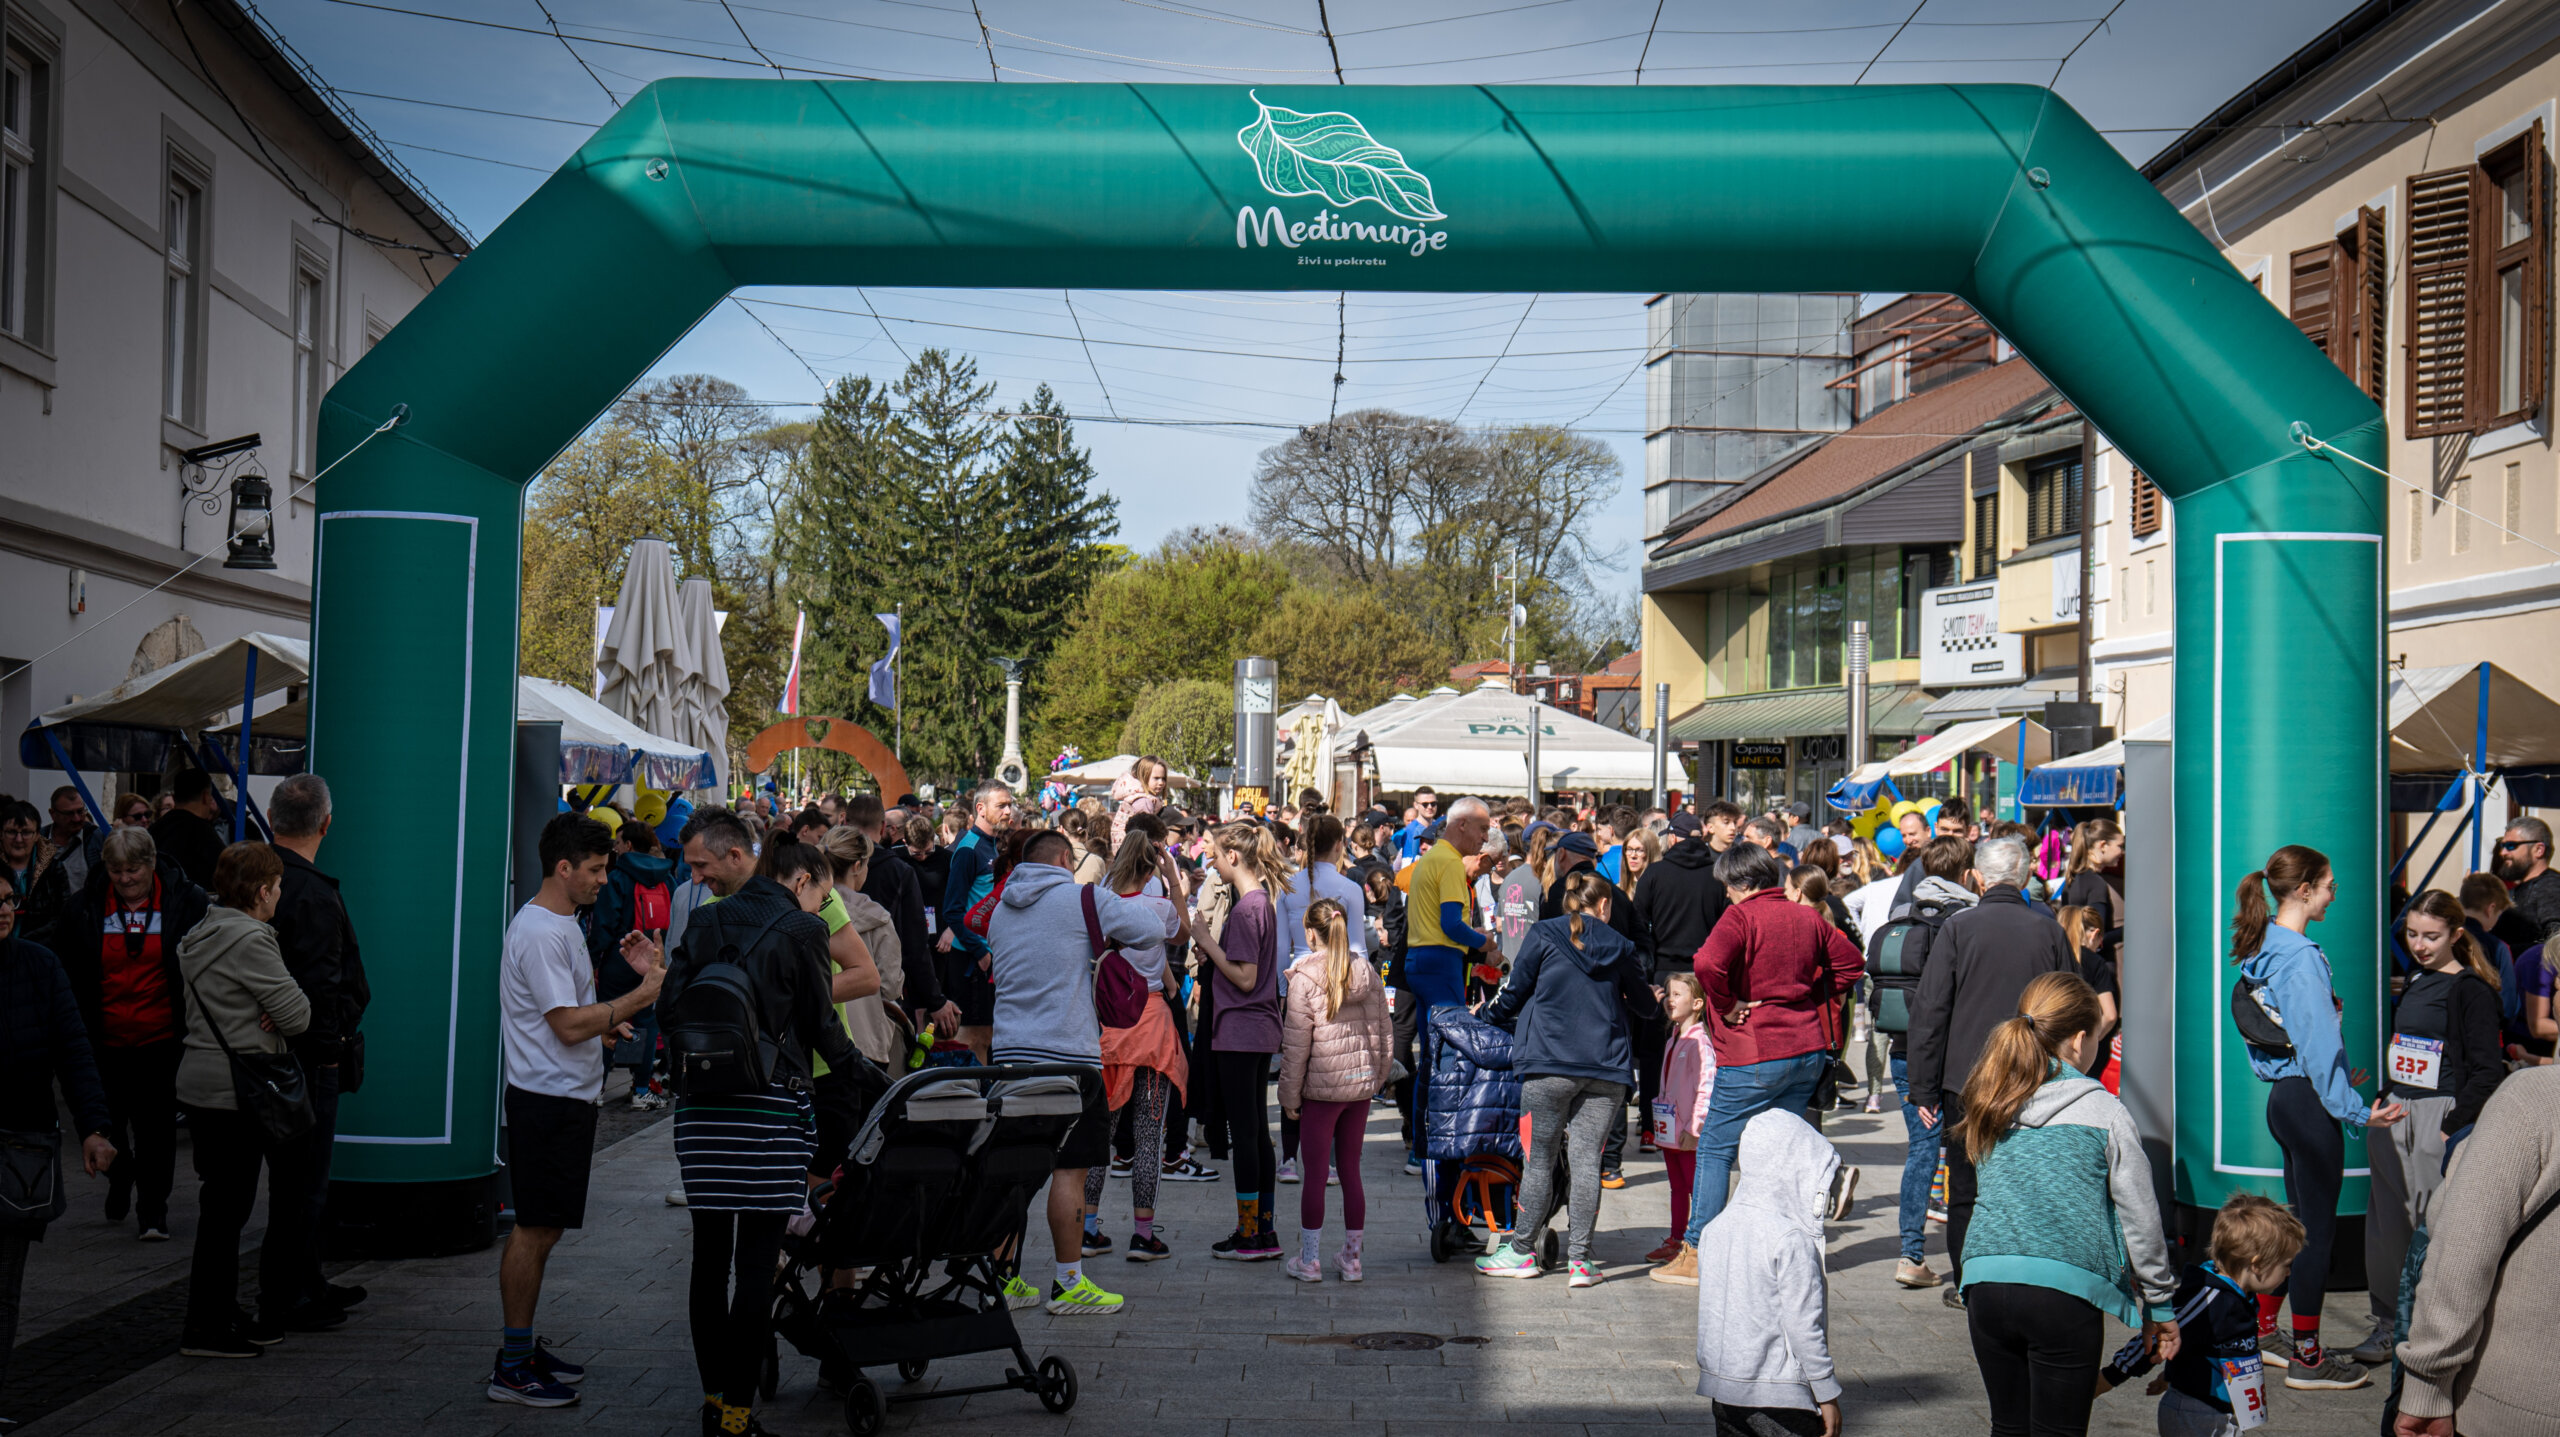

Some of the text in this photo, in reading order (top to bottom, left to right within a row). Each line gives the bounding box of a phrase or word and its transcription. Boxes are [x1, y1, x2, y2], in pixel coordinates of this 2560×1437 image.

[1237, 206, 1448, 257] Međimurje
[1297, 256, 1321, 265] živi
[1335, 257, 1387, 267] pokretu
[1942, 616, 1967, 639] S-MOTO
[1968, 614, 1986, 635] TEAM
[1468, 723, 1556, 735] PAN
[1735, 745, 1782, 756] Optika
[1735, 756, 1782, 765] LINETA
[2396, 1055, 2428, 1075] 237
